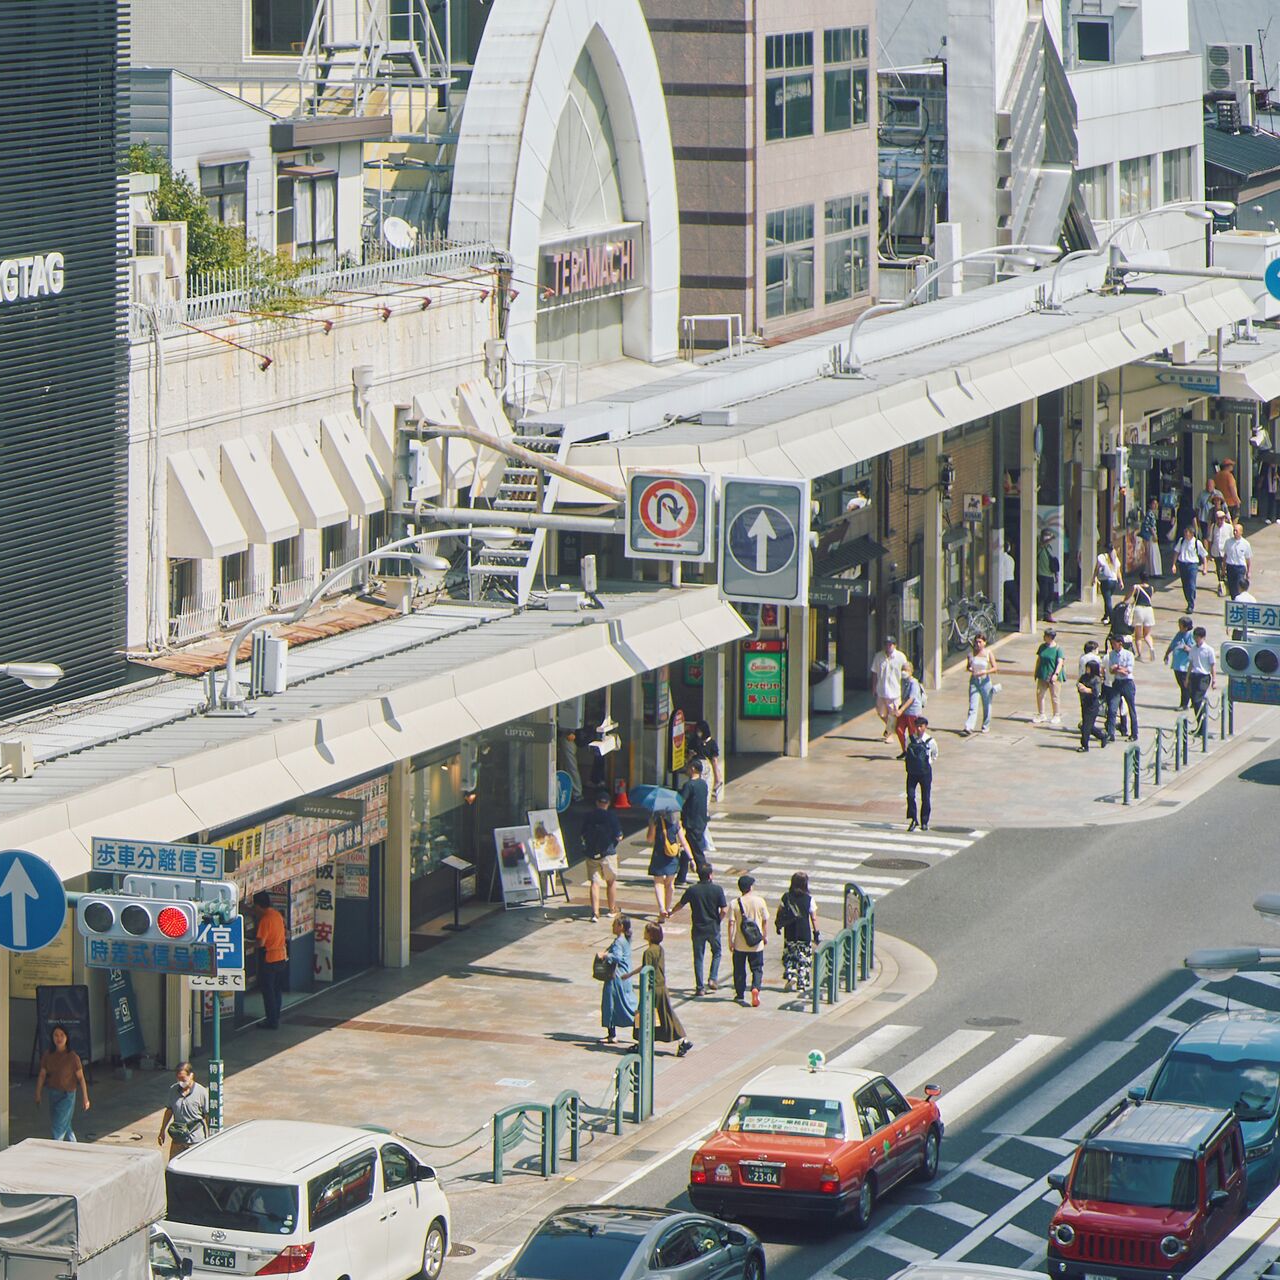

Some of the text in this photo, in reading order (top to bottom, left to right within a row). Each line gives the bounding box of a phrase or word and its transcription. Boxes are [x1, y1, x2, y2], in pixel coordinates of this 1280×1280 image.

[553, 239, 635, 297] TERAMACHI
[1229, 605, 1280, 627] 歩車分
[504, 727, 535, 737] LIPTON
[96, 843, 218, 875] 歩車分離信号
[197, 923, 235, 960] 停
